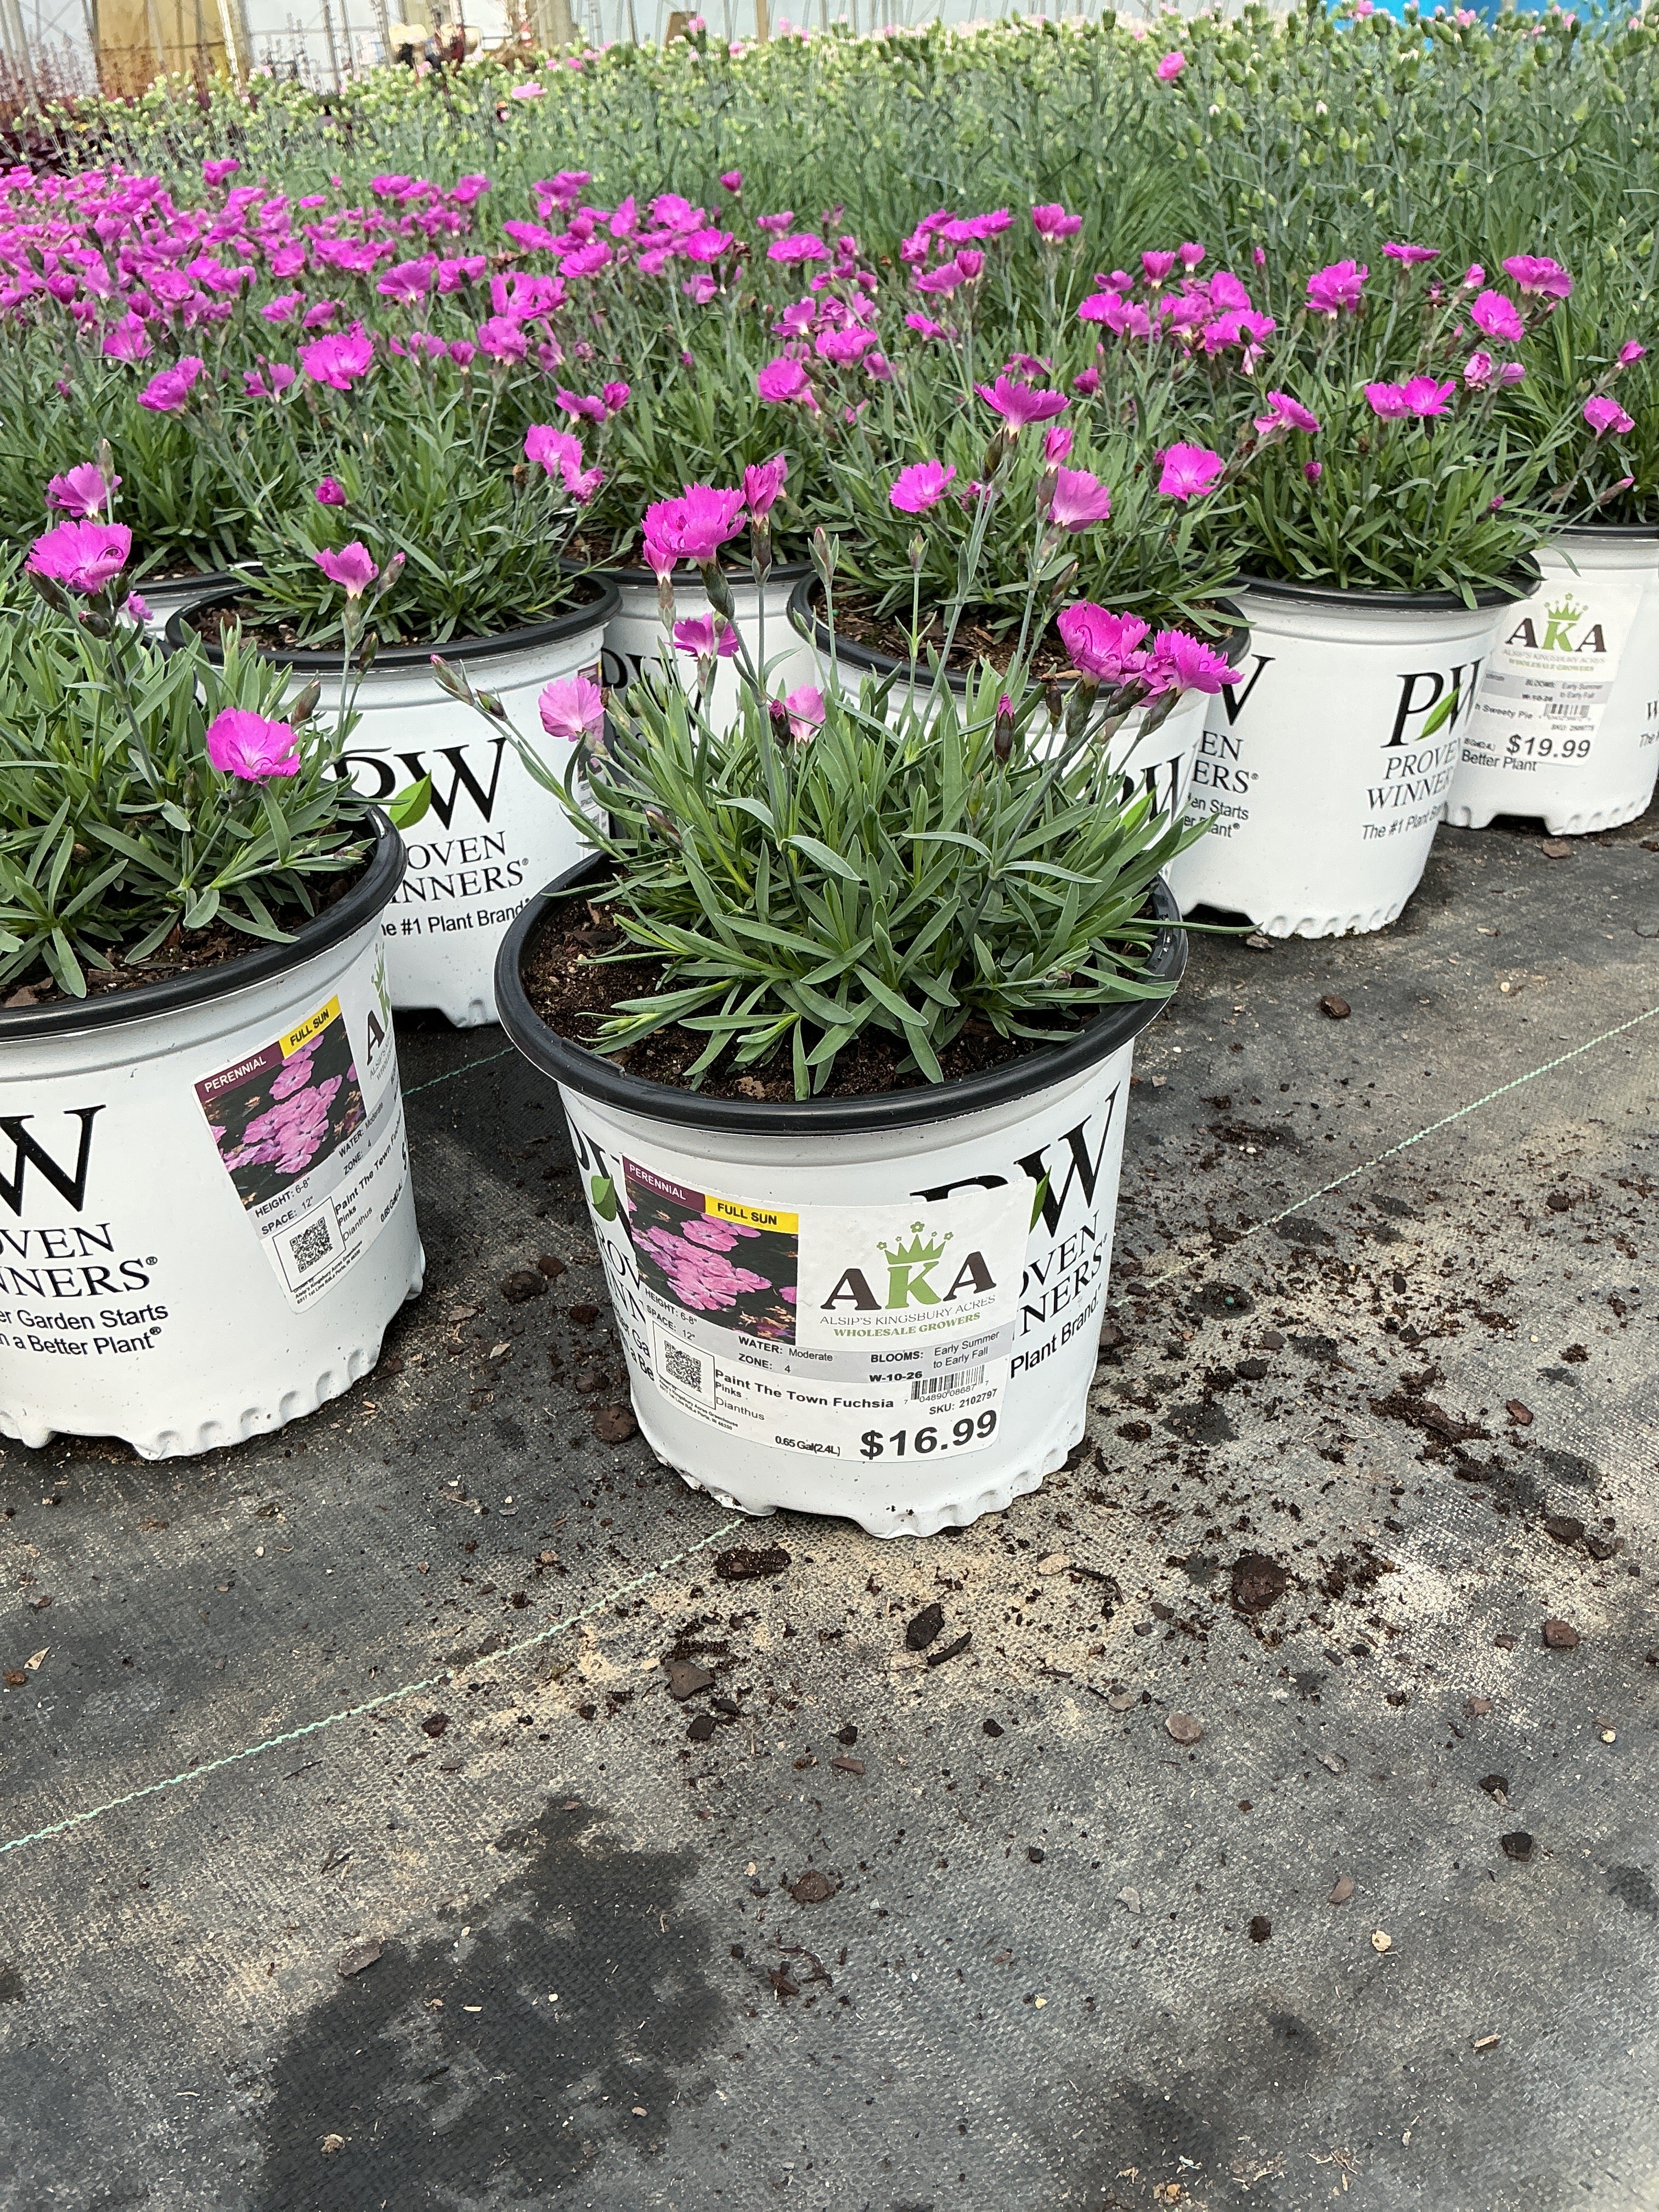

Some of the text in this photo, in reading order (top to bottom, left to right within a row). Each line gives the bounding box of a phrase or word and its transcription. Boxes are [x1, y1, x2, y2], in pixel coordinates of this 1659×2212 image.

[1505, 618, 1607, 653] AKA
[1383, 738, 1460, 781] PROVE
[1462, 749, 1500, 768] Better
[1506, 733, 1591, 758] $19.99
[1210, 799, 1249, 820] Starts
[407, 831, 506, 870] OVEN
[400, 917, 422, 936] #1
[428, 912, 473, 934] Plant
[290, 1008, 330, 1047] FULL SUN
[204, 1056, 267, 1093] PERENNIAL
[338, 1102, 383, 1158] WATER: Moderate
[0, 1104, 106, 1216] W
[343, 1139, 372, 1176] ZONE: 4
[335, 1187, 359, 1215] Paint
[358, 1170, 374, 1190] The
[374, 1143, 391, 1171] Town
[629, 1163, 777, 1225] PERENNIAL FULL SUN
[255, 1188, 295, 1218] HEIGHT:
[338, 1205, 357, 1227] Pinks
[261, 1209, 297, 1235] SPACE:
[343, 1207, 373, 1242] Dianthus
[0, 1223, 115, 1259] VEN
[820, 1251, 997, 1311] AKA
[17, 1309, 95, 1330] Garden
[102, 1304, 169, 1328] Starts
[645, 1288, 679, 1318] HEIGHT:
[680, 1311, 697, 1325] 6-8"
[646, 1305, 678, 1333] SPACE:
[820, 1295, 996, 1325] ALSIP'S KINGSBURY ACRES
[833, 1312, 980, 1338] WHOLESALE GROWERS
[13, 1336, 26, 1349] a
[27, 1334, 88, 1355] Better
[738, 1331, 1000, 1364] WATER: Moderate BLOOMS: Early Summer
[738, 1346, 988, 1374] ZONE: 4 to Early Fall
[1011, 1333, 1057, 1379] Plant
[715, 1368, 894, 1408] Paint The Town Fuchsia
[715, 1381, 742, 1398] Pinks
[868, 1370, 923, 1383] W-10-26
[716, 1396, 765, 1421] Dianthus
[929, 1388, 998, 1415] SKU: 2102797
[775, 1435, 795, 1448] 0.65
[860, 1409, 997, 1460] $16.99
